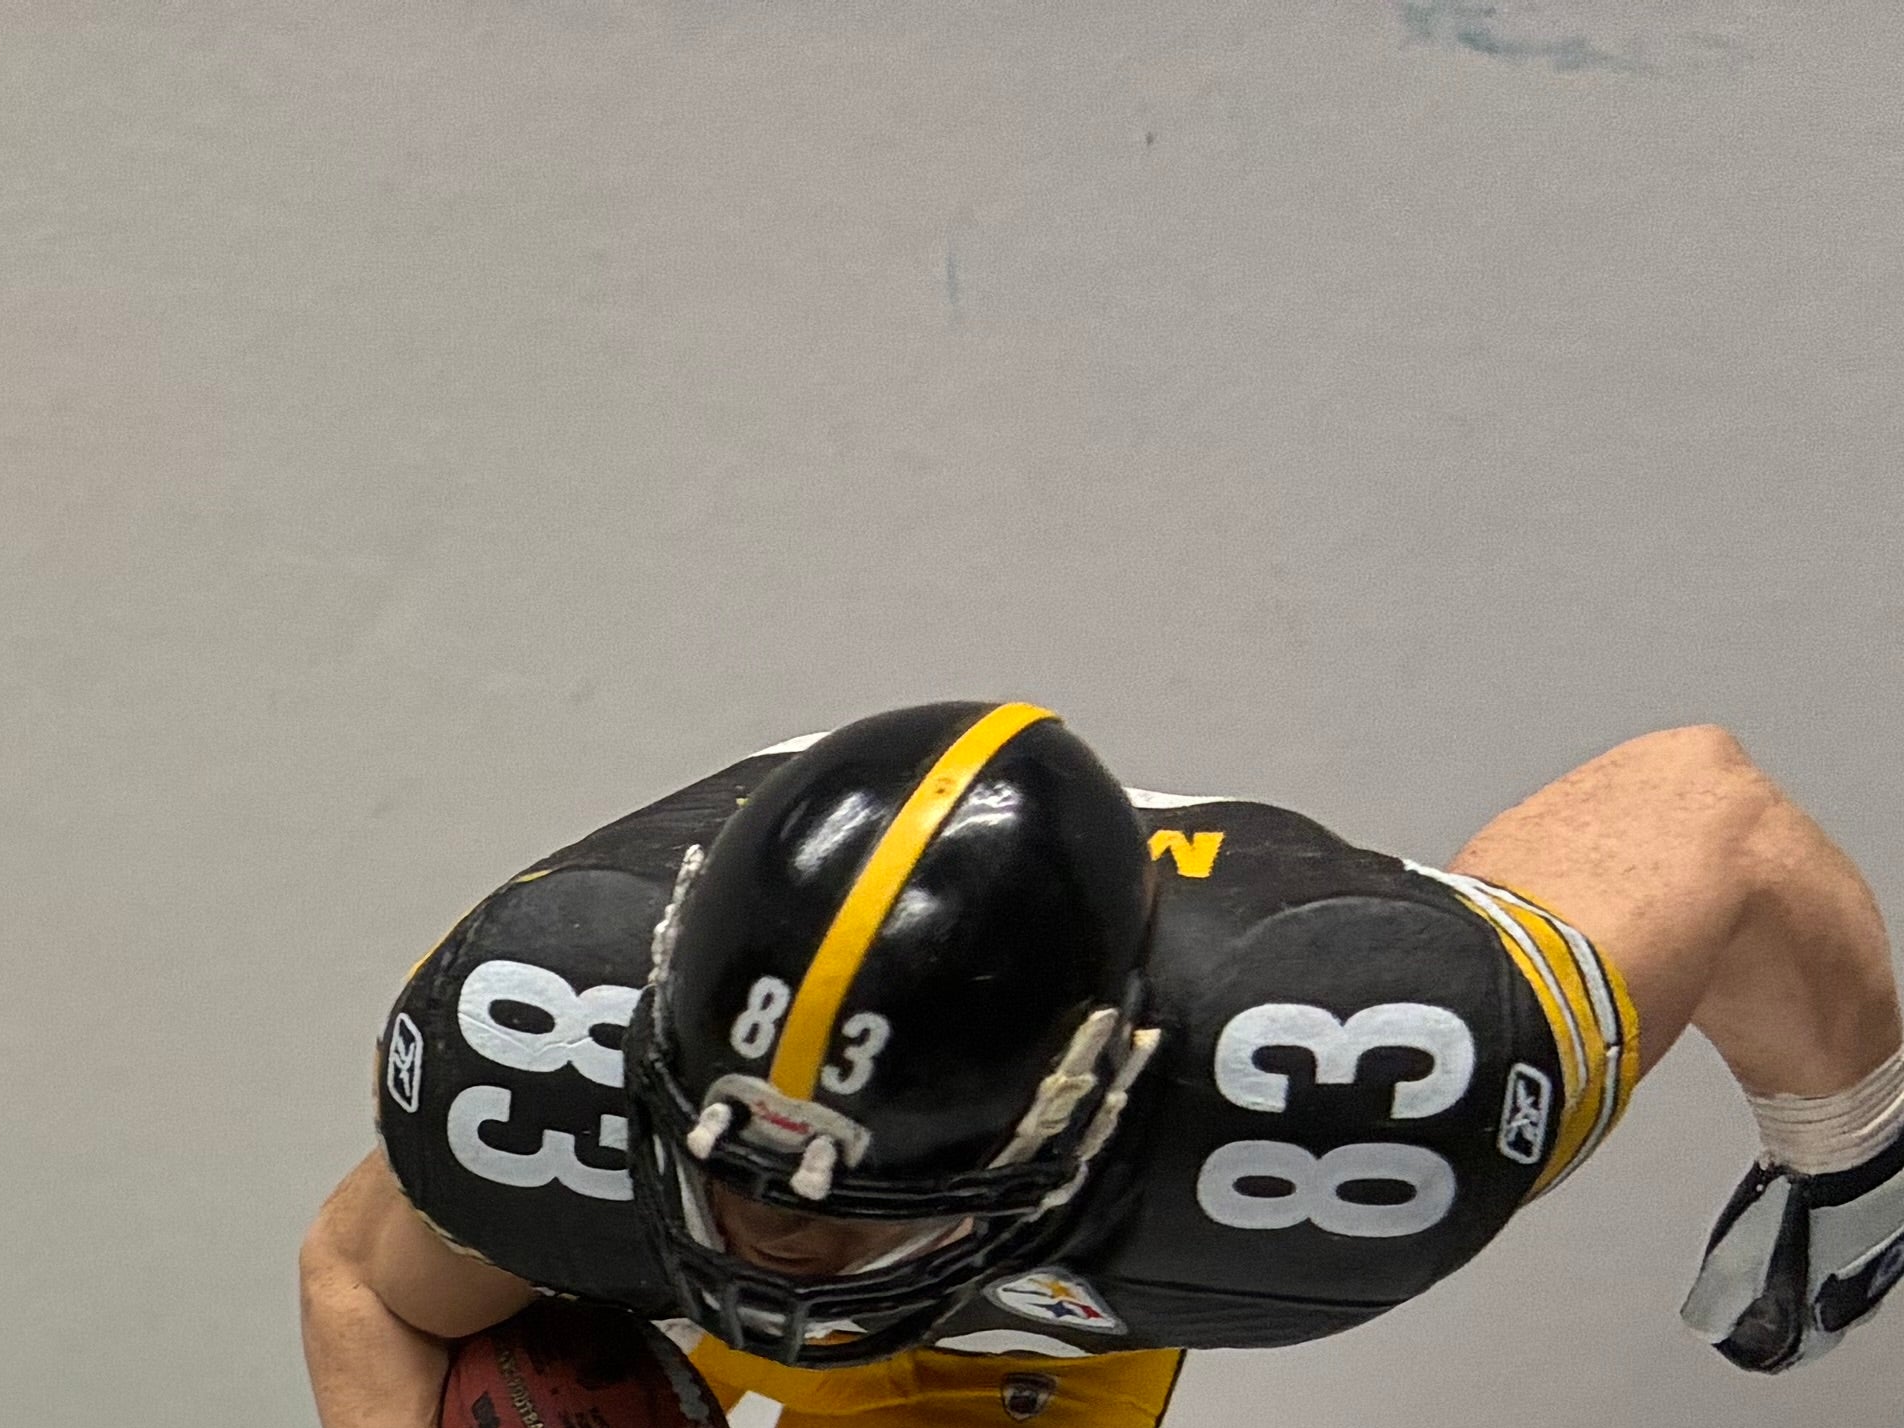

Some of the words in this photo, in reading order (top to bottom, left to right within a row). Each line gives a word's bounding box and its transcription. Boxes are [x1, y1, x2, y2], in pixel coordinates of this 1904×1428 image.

[445, 959, 637, 1204] 83
[730, 976, 890, 1095] 83
[1196, 1000, 1477, 1239] 83
